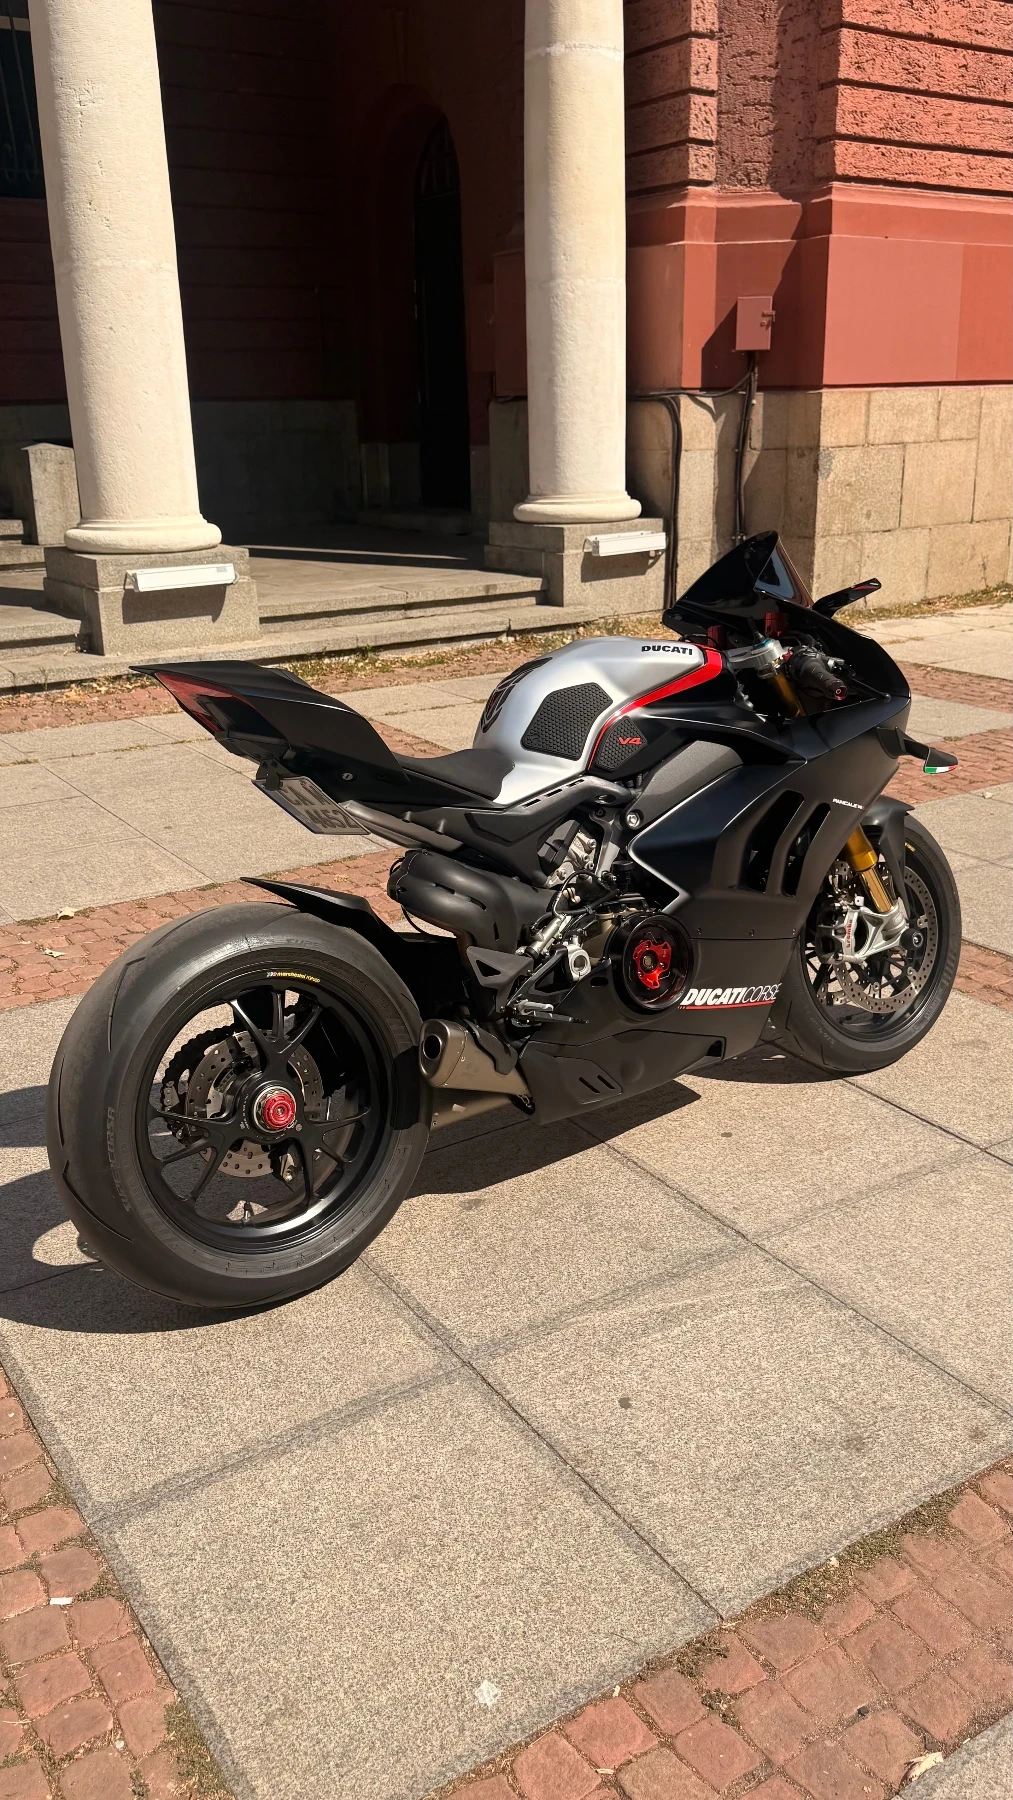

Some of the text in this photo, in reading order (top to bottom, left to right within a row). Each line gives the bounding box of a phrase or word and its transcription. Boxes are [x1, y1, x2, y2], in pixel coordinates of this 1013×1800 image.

[641, 645, 693, 655] DUCATI
[619, 737, 642, 745] V4
[304, 809, 361, 829] 4652
[845, 919, 853, 948] brembo
